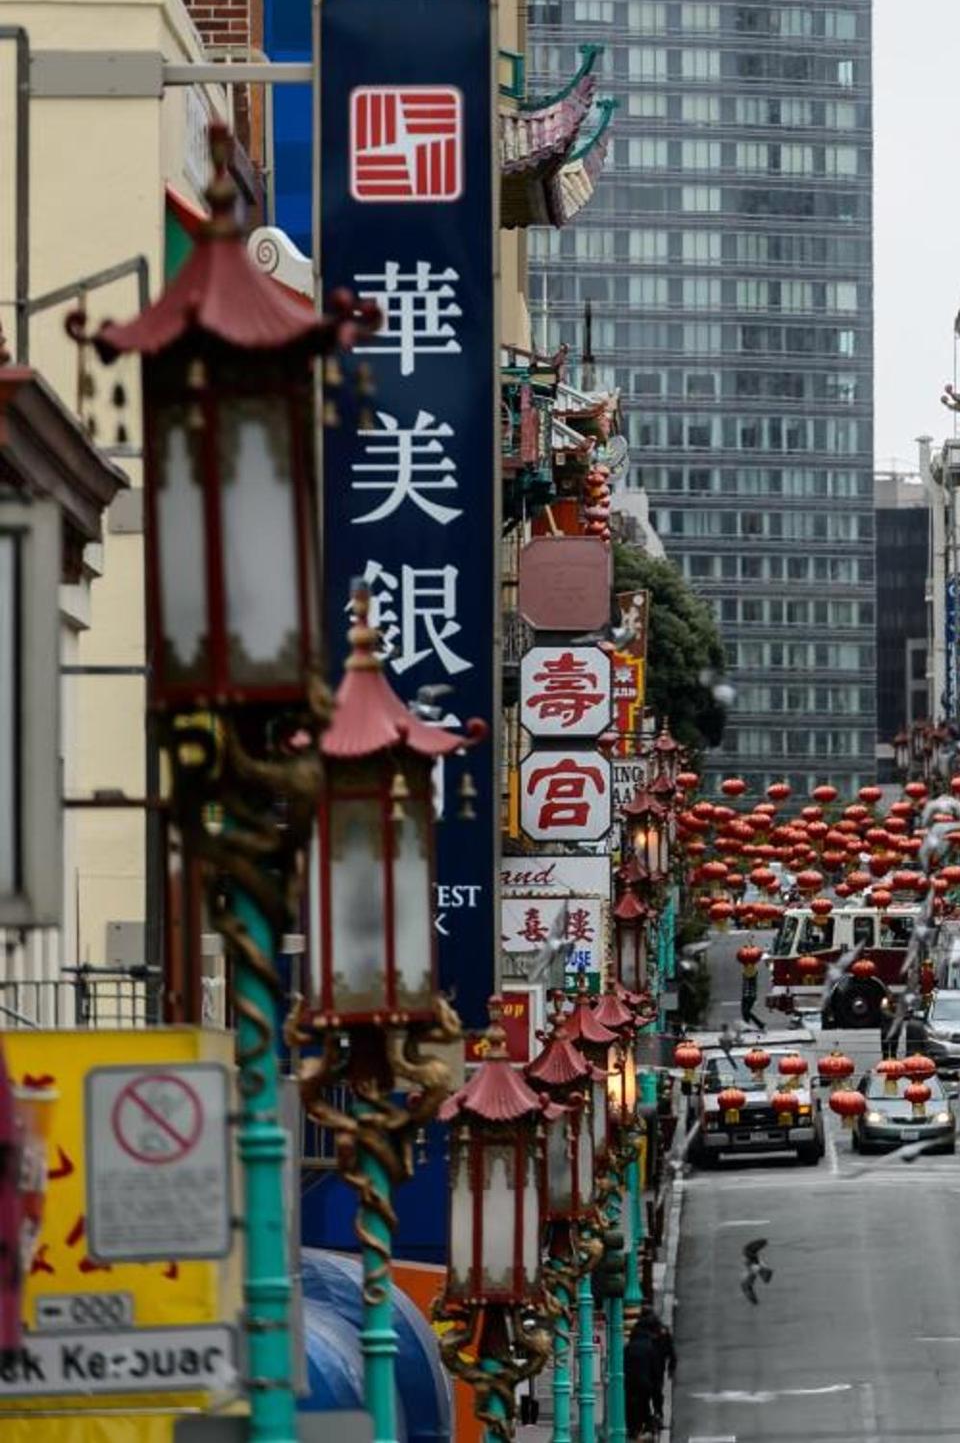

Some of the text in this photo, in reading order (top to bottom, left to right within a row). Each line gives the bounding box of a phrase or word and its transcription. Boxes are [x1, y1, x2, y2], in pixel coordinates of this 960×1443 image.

[500, 862, 557, 885] and
[437, 885, 482, 908] EST
[502, 1003, 524, 1019] op
